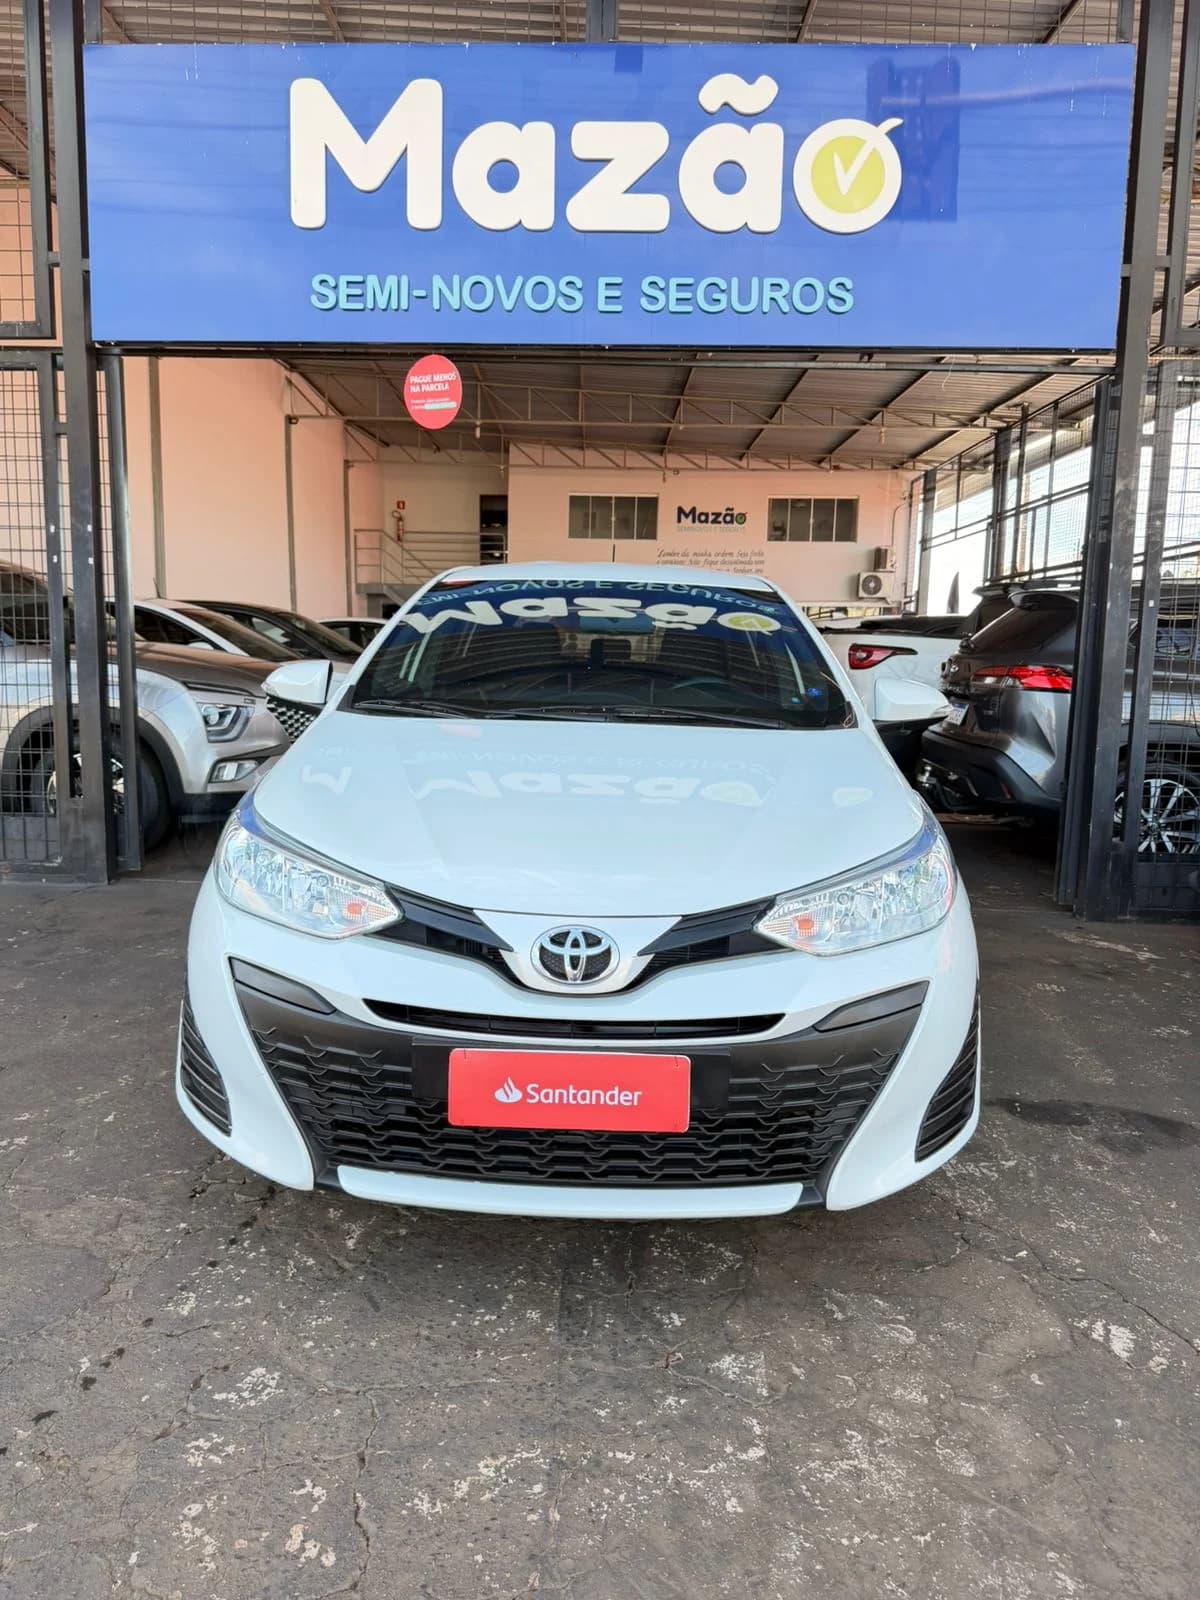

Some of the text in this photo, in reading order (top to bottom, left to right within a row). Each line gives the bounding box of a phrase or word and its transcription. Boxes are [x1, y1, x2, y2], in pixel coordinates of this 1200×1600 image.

[289, 73, 904, 234] Mazão
[310, 274, 855, 314] SEMI-NOVOS E SEGUROS
[409, 372, 457, 384] PAGUE MENOS
[421, 383, 449, 392] PARCELA
[676, 506, 748, 525] Mazão
[526, 1083, 643, 1106] Santander
